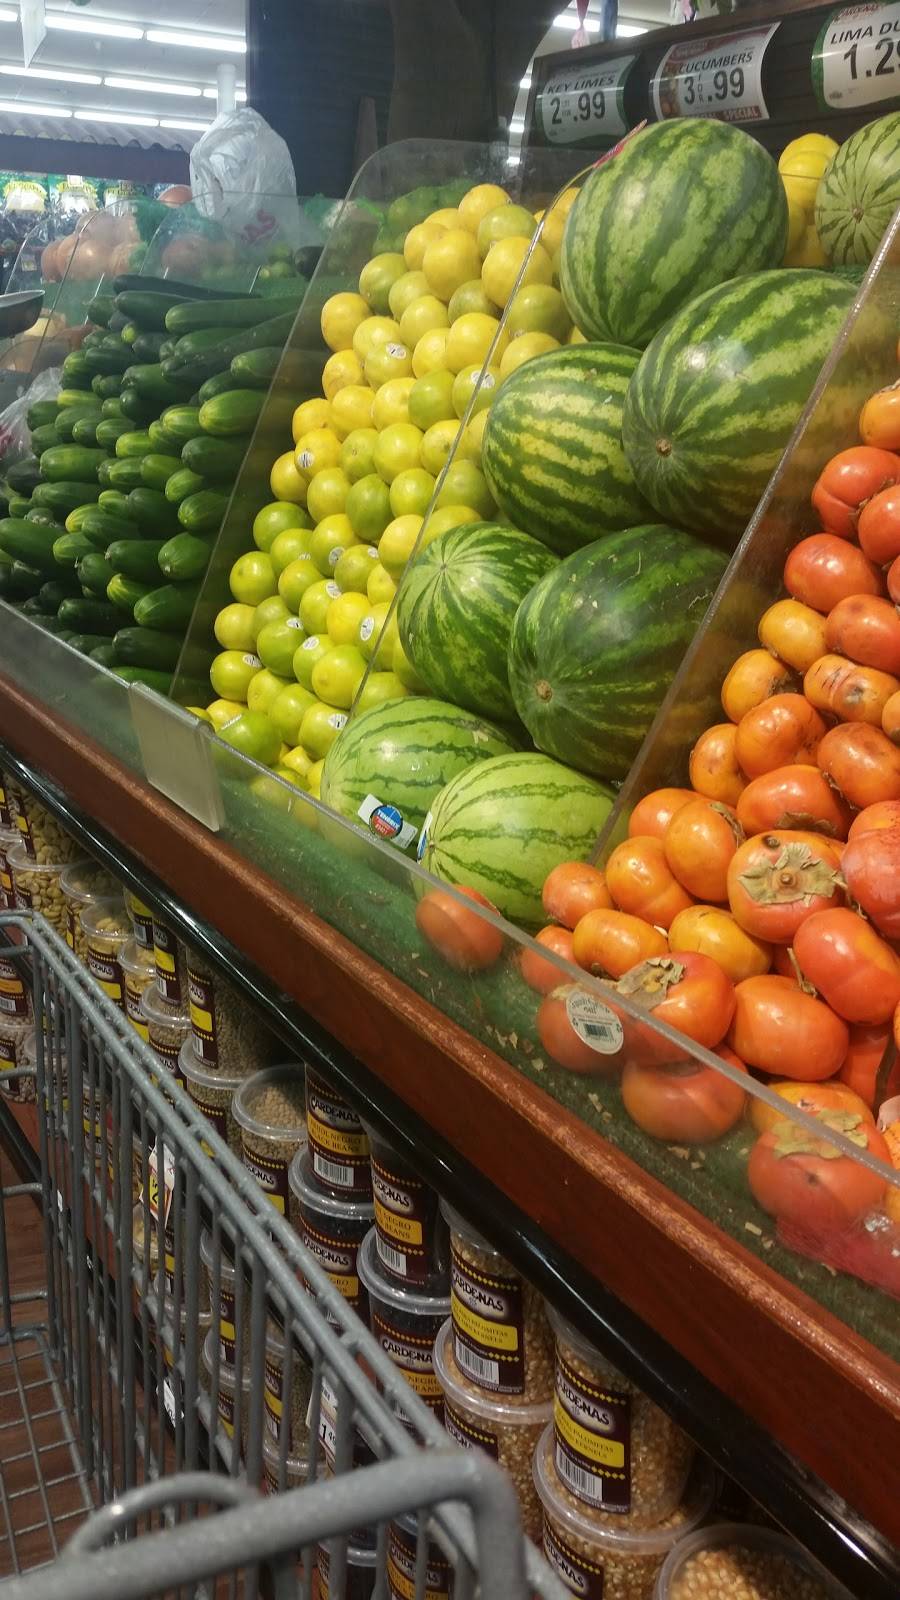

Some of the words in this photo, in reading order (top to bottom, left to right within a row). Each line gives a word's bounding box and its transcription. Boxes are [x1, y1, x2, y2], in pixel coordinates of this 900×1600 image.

[831, 25, 873, 44] LIMA
[679, 50, 753, 74] CUCUMBERS
[546, 83, 572, 95] KEY
[574, 76, 615, 90] LIMES
[310, 1096, 360, 1123] CARDENAS
[304, 1235, 349, 1265] CARDENAS
